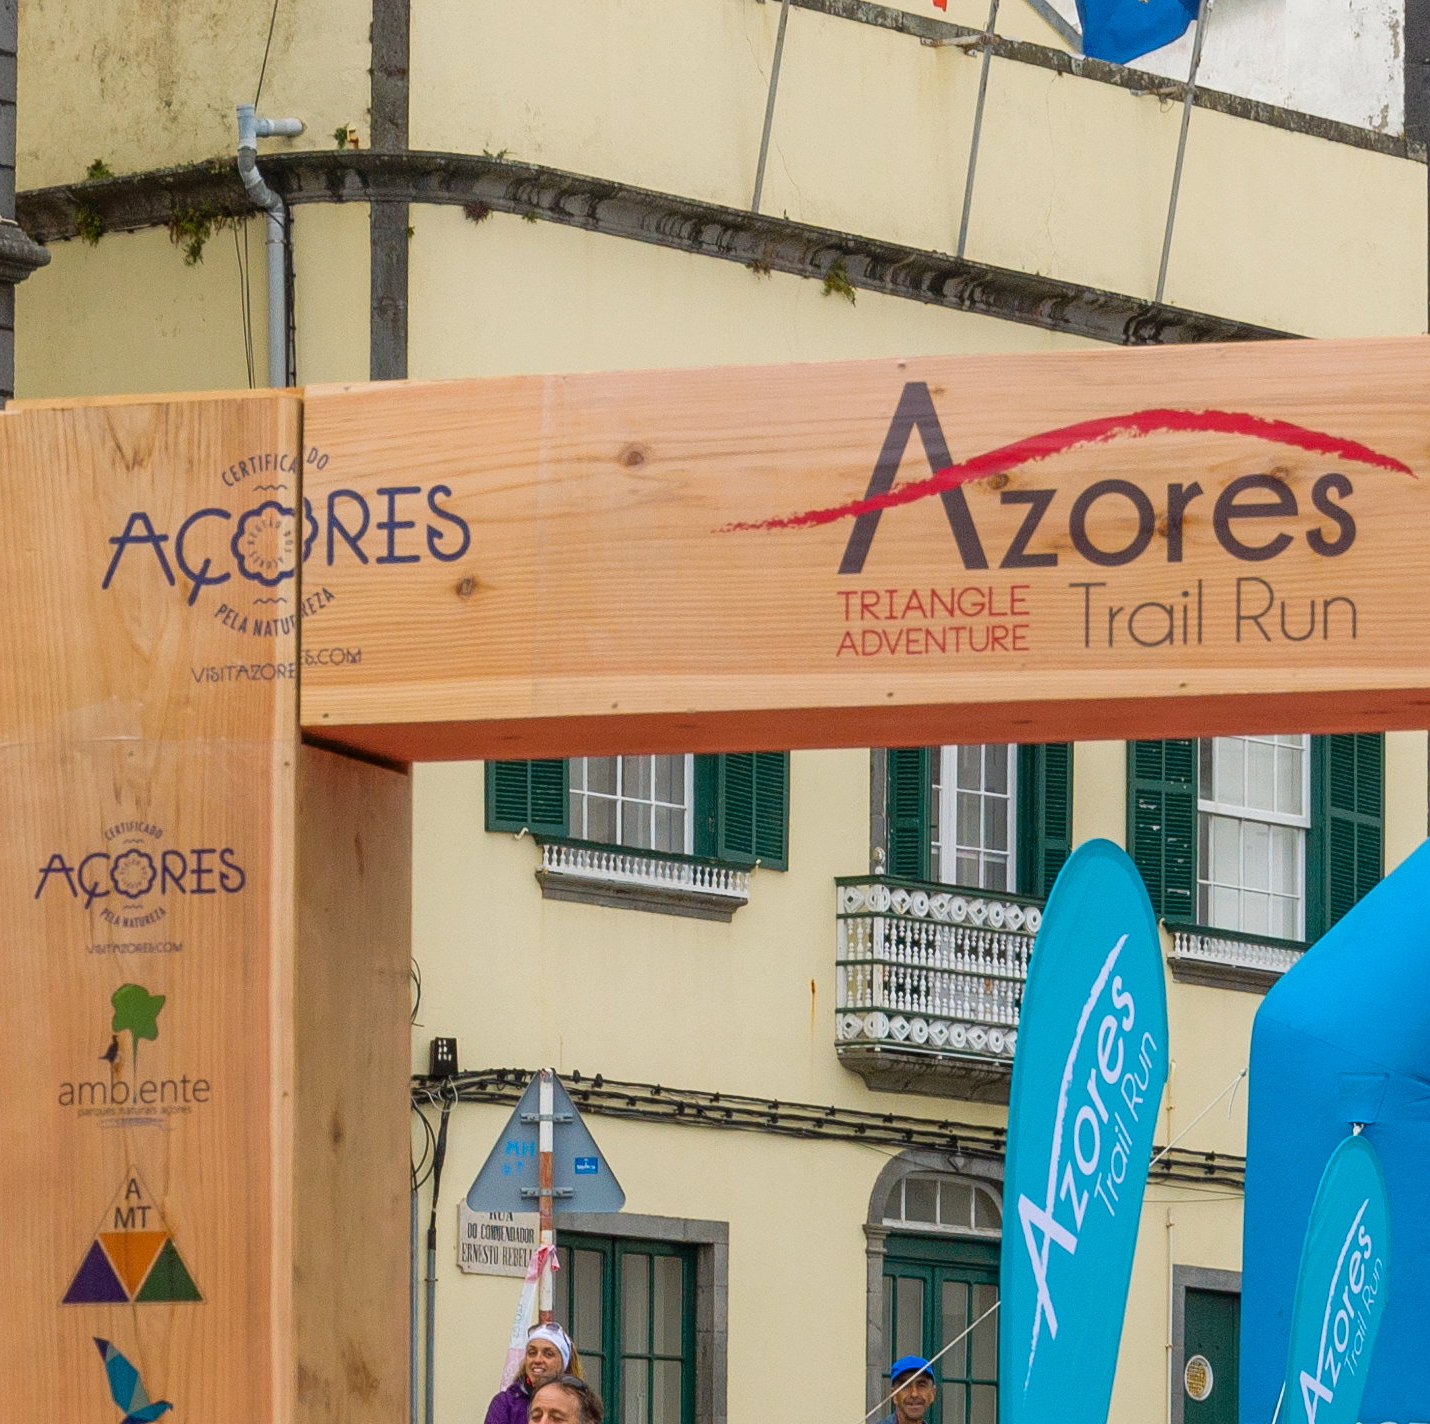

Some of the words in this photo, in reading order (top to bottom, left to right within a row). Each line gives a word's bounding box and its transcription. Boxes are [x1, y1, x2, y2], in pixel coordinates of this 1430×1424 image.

[221, 447, 331, 486] CERTIFICADO
[837, 381, 1357, 575] Azores
[100, 484, 472, 607] AÇORES
[213, 603, 250, 635] PELA
[253, 586, 337, 638] NATUREZA
[836, 584, 1031, 622] TRIANGLE
[1068, 577, 1204, 649] Trail
[1235, 576, 1358, 643] Run
[836, 623, 1031, 657] ADVENTURE
[190, 646, 363, 684] VISITAZORES.COM
[104, 820, 165, 841] CERTIFICADO
[34, 847, 247, 911] AÇORES
[99, 906, 121, 926] PELA
[121, 906, 168, 928] NATUREZA
[57, 1072, 211, 1107] ambiente
[1093, 1112, 1133, 1218] Trail
[1120, 1030, 1158, 1123] Run
[1018, 975, 1136, 1340] Azores
[124, 1178, 142, 1201] A
[113, 1205, 152, 1229] MT
[467, 1222, 478, 1240] DO
[461, 1242, 499, 1265] ERNESTO
[1343, 1305, 1369, 1379] Trail
[1362, 1257, 1384, 1307] Run
